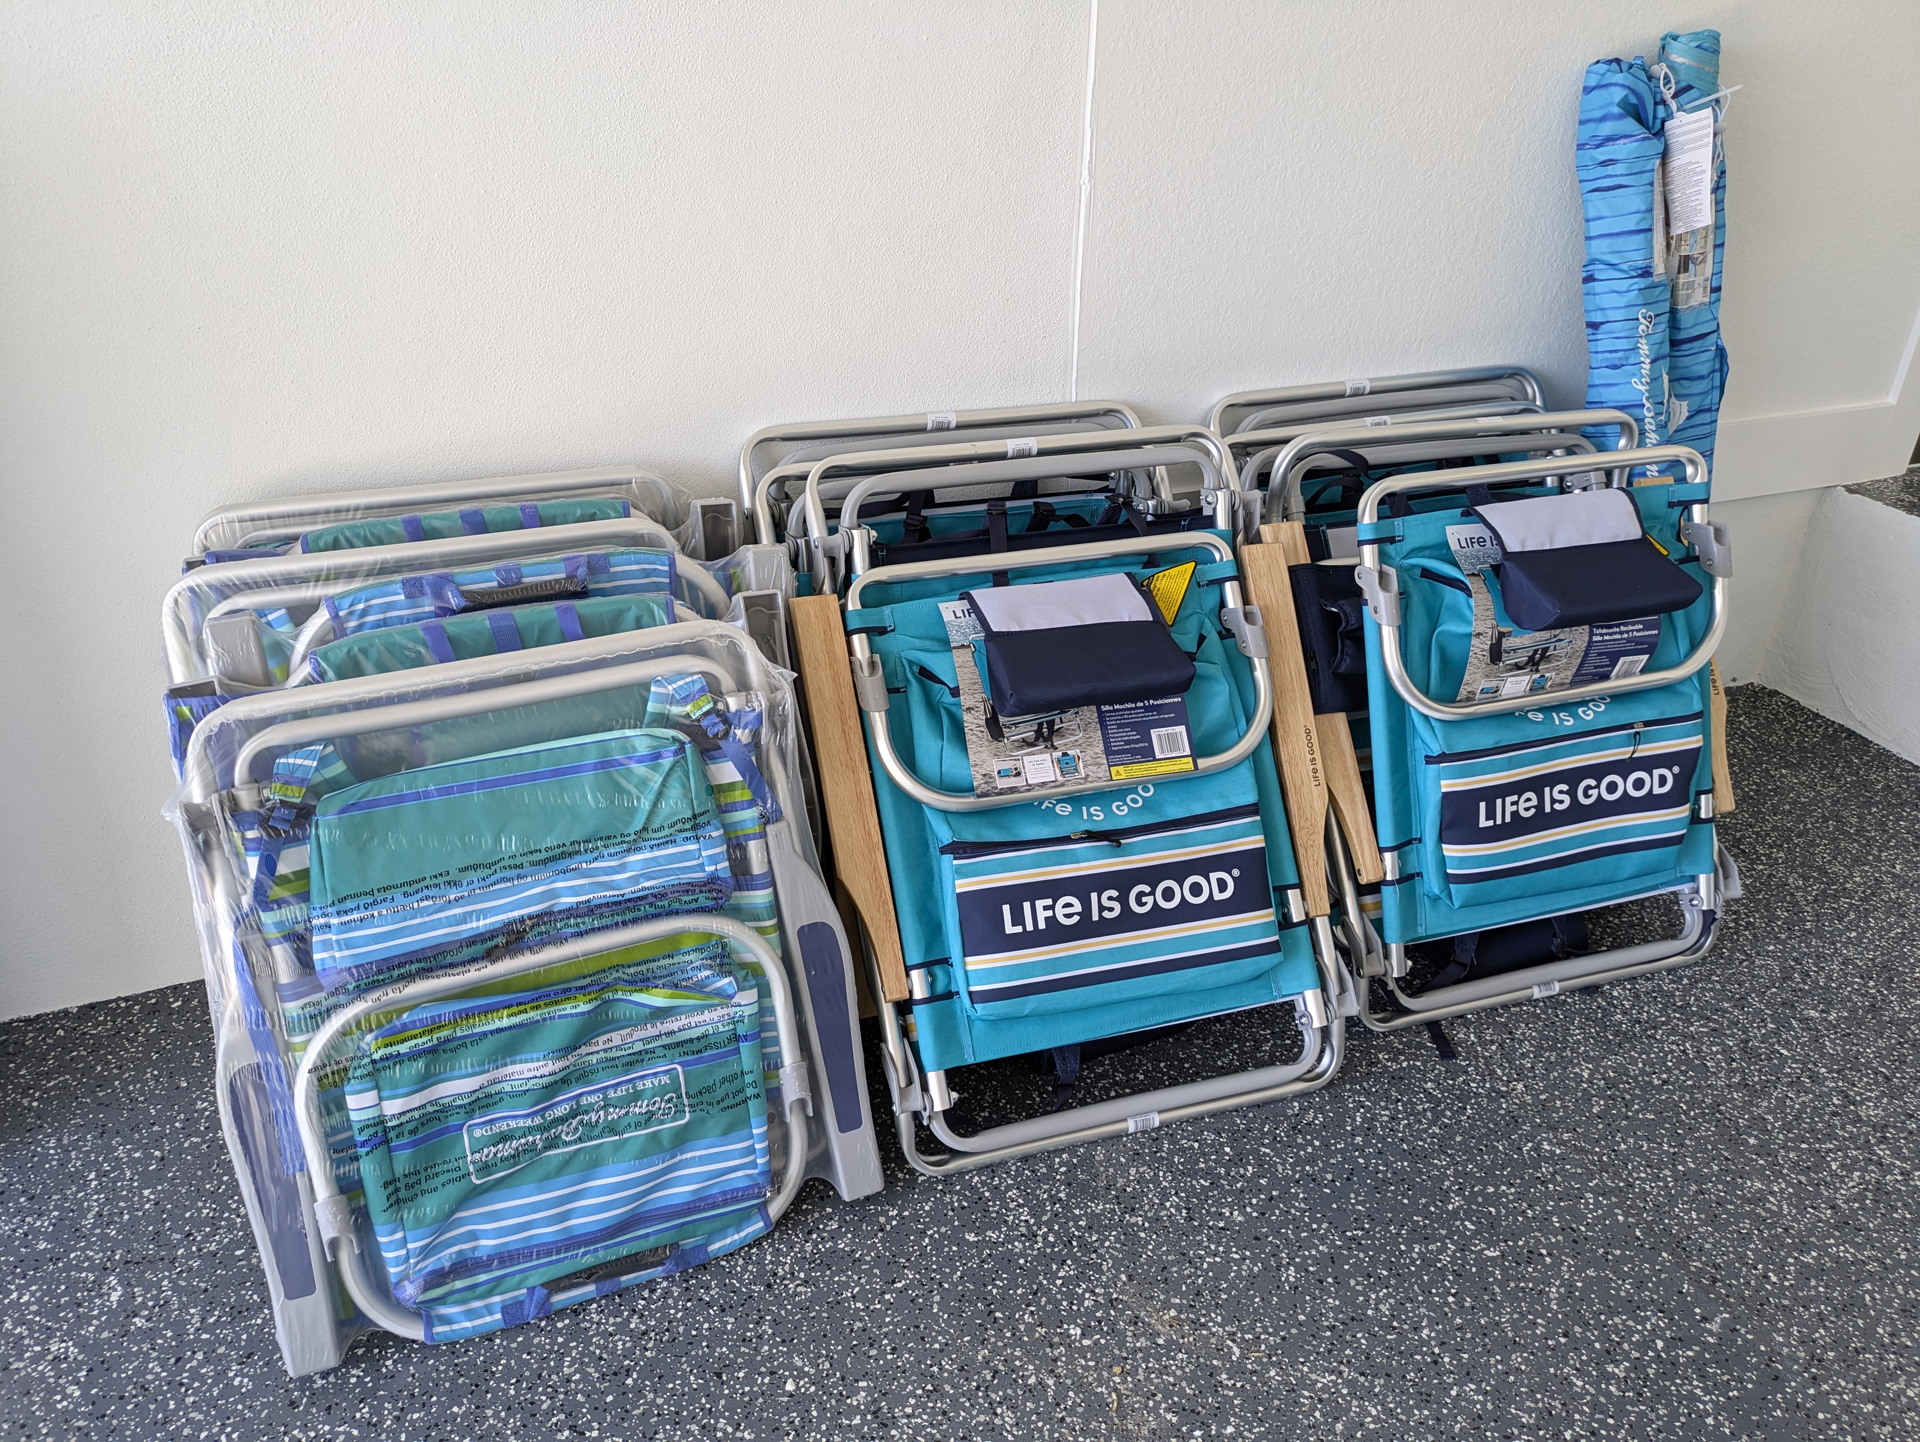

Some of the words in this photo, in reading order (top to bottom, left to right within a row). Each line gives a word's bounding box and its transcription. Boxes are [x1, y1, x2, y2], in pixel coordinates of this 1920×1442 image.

[1620, 623, 1643, 631] Reclinable
[1114, 702, 1136, 710] Mochila
[1552, 712, 1574, 726] IS
[1309, 756, 1317, 766] IS
[1082, 805, 1105, 821] IS
[1112, 783, 1155, 816] GOO
[1544, 784, 1571, 814] IS
[650, 824, 665, 833] um
[428, 870, 450, 881] Ekki
[476, 868, 497, 884] poki
[516, 873, 527, 882] og
[376, 875, 427, 895] endurnota
[442, 879, 462, 890] ekki
[464, 878, 474, 887] er
[336, 888, 375, 905] þennan
[362, 894, 394, 910] Fargið
[309, 900, 335, 913] poka.
[335, 904, 360, 917] poka
[1091, 889, 1121, 922] IS
[679, 941, 719, 959] producto.
[489, 954, 506, 965] den
[645, 966, 654, 974] la
[669, 968, 733, 989] ADVERTENCIA:
[390, 976, 417, 995] borta
[553, 986, 572, 997] otro
[297, 999, 323, 1013] leksak.
[529, 1003, 541, 1011] de
[543, 994, 577, 1008] carritos
[684, 1010, 705, 1020] avoir
[716, 1012, 730, 1020] sac
[459, 1018, 495, 1033] corrales
[676, 1020, 692, 1031] pas
[710, 1024, 719, 1033] et
[435, 1028, 458, 1044] para
[468, 1032, 488, 1046] esta
[600, 1035, 613, 1045] Ne
[663, 1029, 675, 1038] un
[694, 1028, 710, 1041] des
[404, 1036, 434, 1053] juego.
[441, 1040, 468, 1056] bolsa
[659, 1036, 694, 1052] enfants.
[676, 1030, 748, 1059] AVERTISSEMENT
[378, 1049, 400, 1062] Esta
[406, 1047, 439, 1064] alejada
[646, 1052, 666, 1063] pour
[375, 1063, 391, 1074] los
[392, 1058, 404, 1067] de
[601, 1062, 618, 1071] tout
[572, 1066, 600, 1083] risque
[716, 1071, 739, 1087] other
[635, 1075, 670, 1090] MAKE
[745, 1080, 757, 1089] Do
[606, 1084, 634, 1098] LIFE
[684, 1080, 718, 1101] packing
[730, 1086, 745, 1098] not
[578, 1092, 603, 1105] ONE
[714, 1092, 729, 1104] use
[717, 1092, 761, 1113] WARNING:
[543, 1100, 578, 1119] LONG
[419, 1114, 441, 1128] hors
[527, 1113, 569, 1135] removing
[632, 1119, 642, 1128] of
[406, 1126, 419, 1137] de
[488, 1130, 527, 1150] product.
[543, 1142, 559, 1151] this
[561, 1135, 582, 1147] keep
[498, 1151, 521, 1164] away
[423, 1164, 461, 1182] Discard
[475, 1161, 497, 1173] from
[402, 1168, 420, 1180] this
[379, 1175, 401, 1191] bag.
[402, 1177, 422, 1191] bag
[384, 1186, 403, 1200] and
[419, 1184, 438, 1196] and
[379, 1192, 419, 1214] children.
